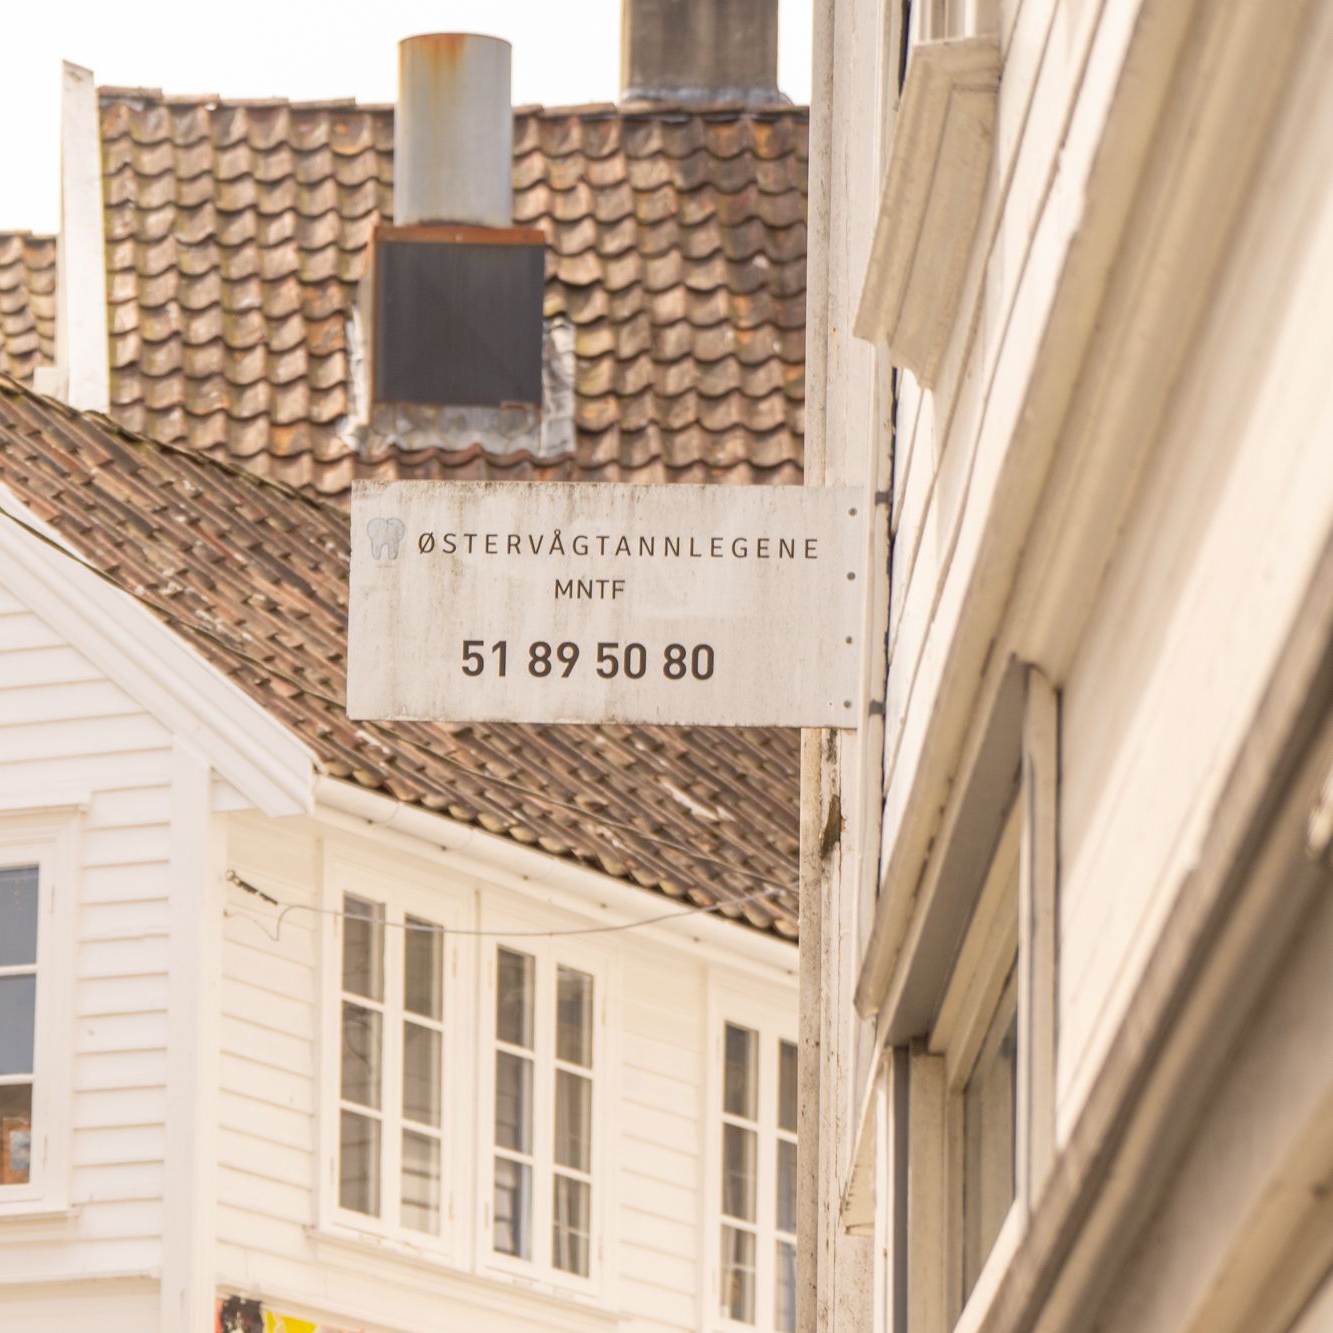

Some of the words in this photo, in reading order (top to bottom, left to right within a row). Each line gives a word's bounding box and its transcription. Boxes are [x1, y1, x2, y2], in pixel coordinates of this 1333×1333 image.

[418, 529, 821, 560] ØSTERVÅGTANNLEGENE
[554, 578, 626, 600] MNTF
[461, 639, 509, 678] 51
[528, 640, 580, 680] 89
[595, 641, 648, 681] 50
[662, 643, 716, 681] 80
